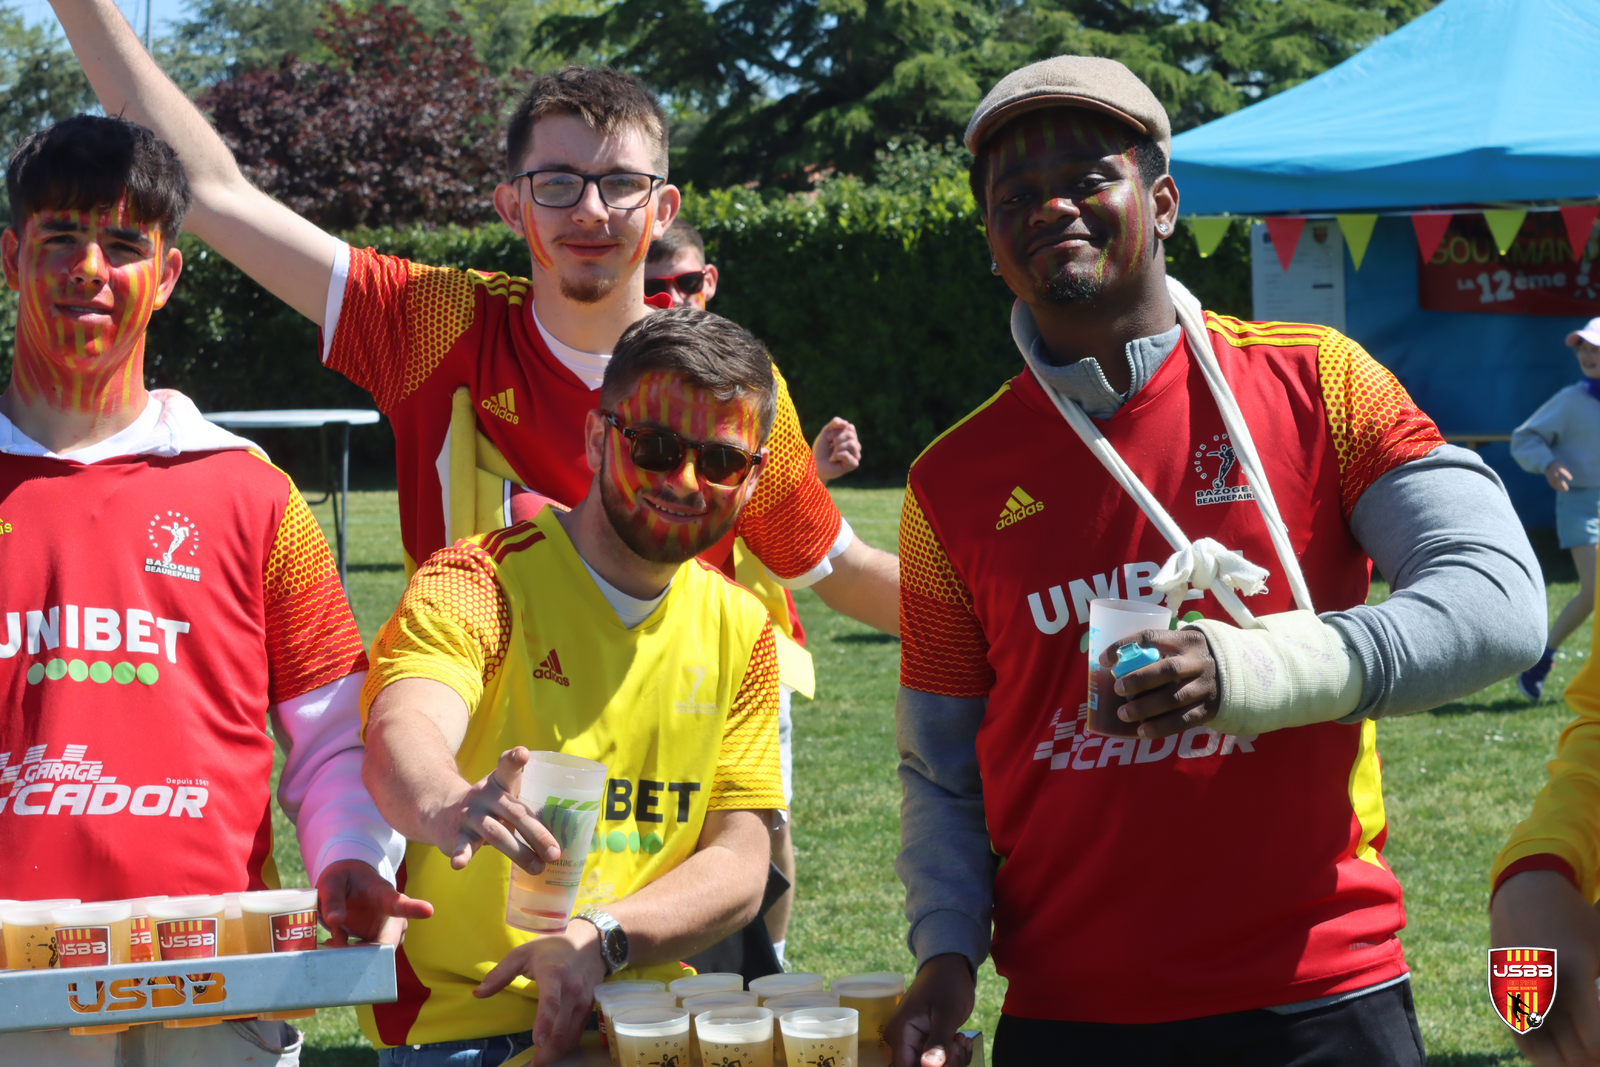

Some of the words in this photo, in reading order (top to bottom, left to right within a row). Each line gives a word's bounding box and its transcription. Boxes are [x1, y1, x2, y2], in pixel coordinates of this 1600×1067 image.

[481, 398, 520, 425] adidas
[1196, 485, 1252, 498] BAZOGE
[996, 500, 1045, 530] adidas
[144, 564, 201, 582] BEAUREPAIRE
[145, 557, 200, 575] BAZOGES
[0, 604, 190, 663] UNIBET
[24, 762, 103, 782] GARAGE
[166, 777, 193, 786] Depuis
[13, 783, 209, 819] CADOR
[601, 778, 701, 823] BET
[58, 941, 107, 956] USBB
[160, 932, 216, 949] USBB
[68, 972, 228, 1014] USBB
